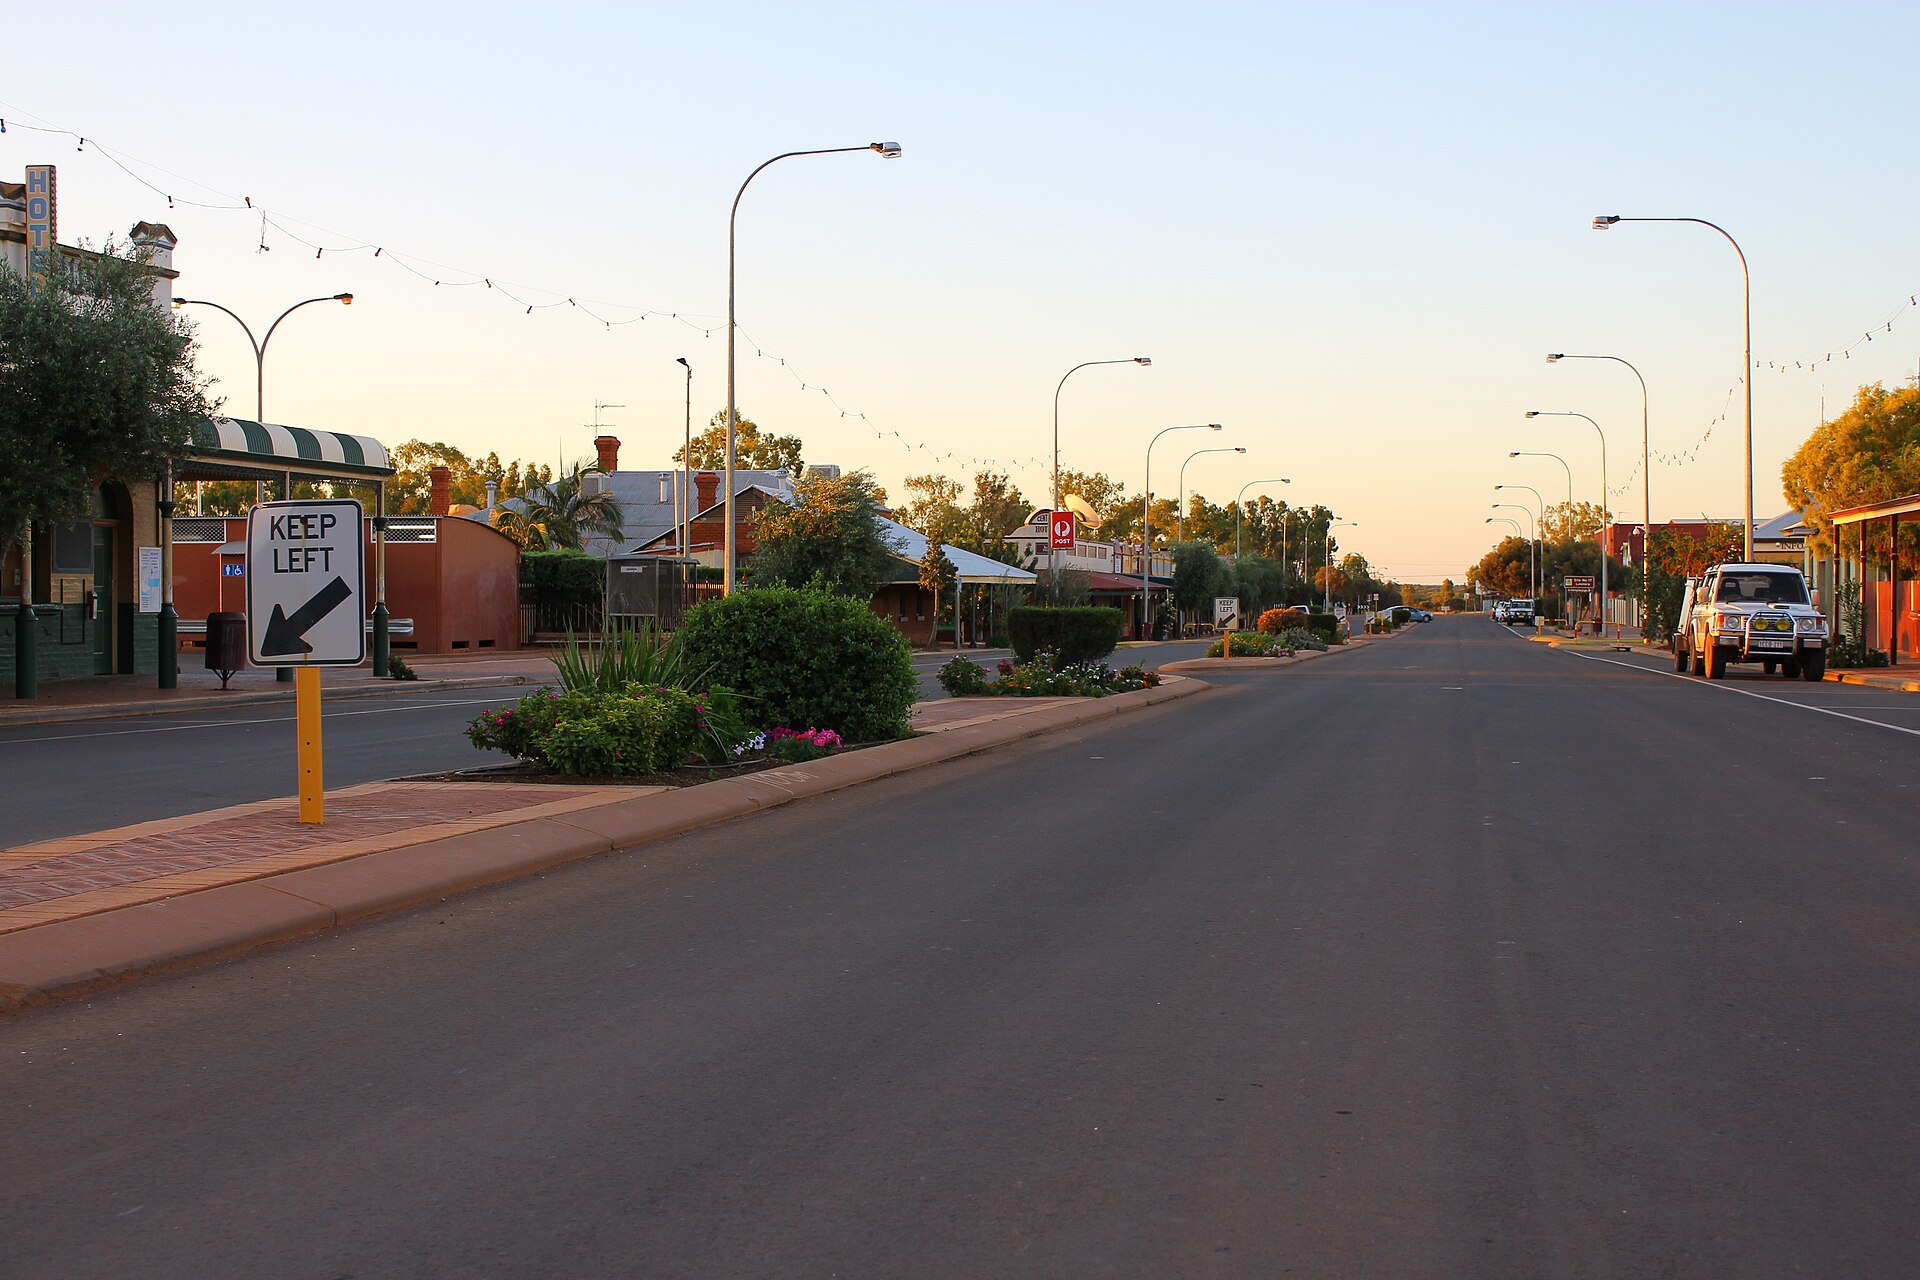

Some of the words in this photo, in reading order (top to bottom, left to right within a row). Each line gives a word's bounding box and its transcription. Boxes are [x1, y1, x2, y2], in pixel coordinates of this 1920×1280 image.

[270, 513, 337, 540] KEEP
[1781, 542, 1804, 550] INFO
[273, 546, 334, 574] LEFT
